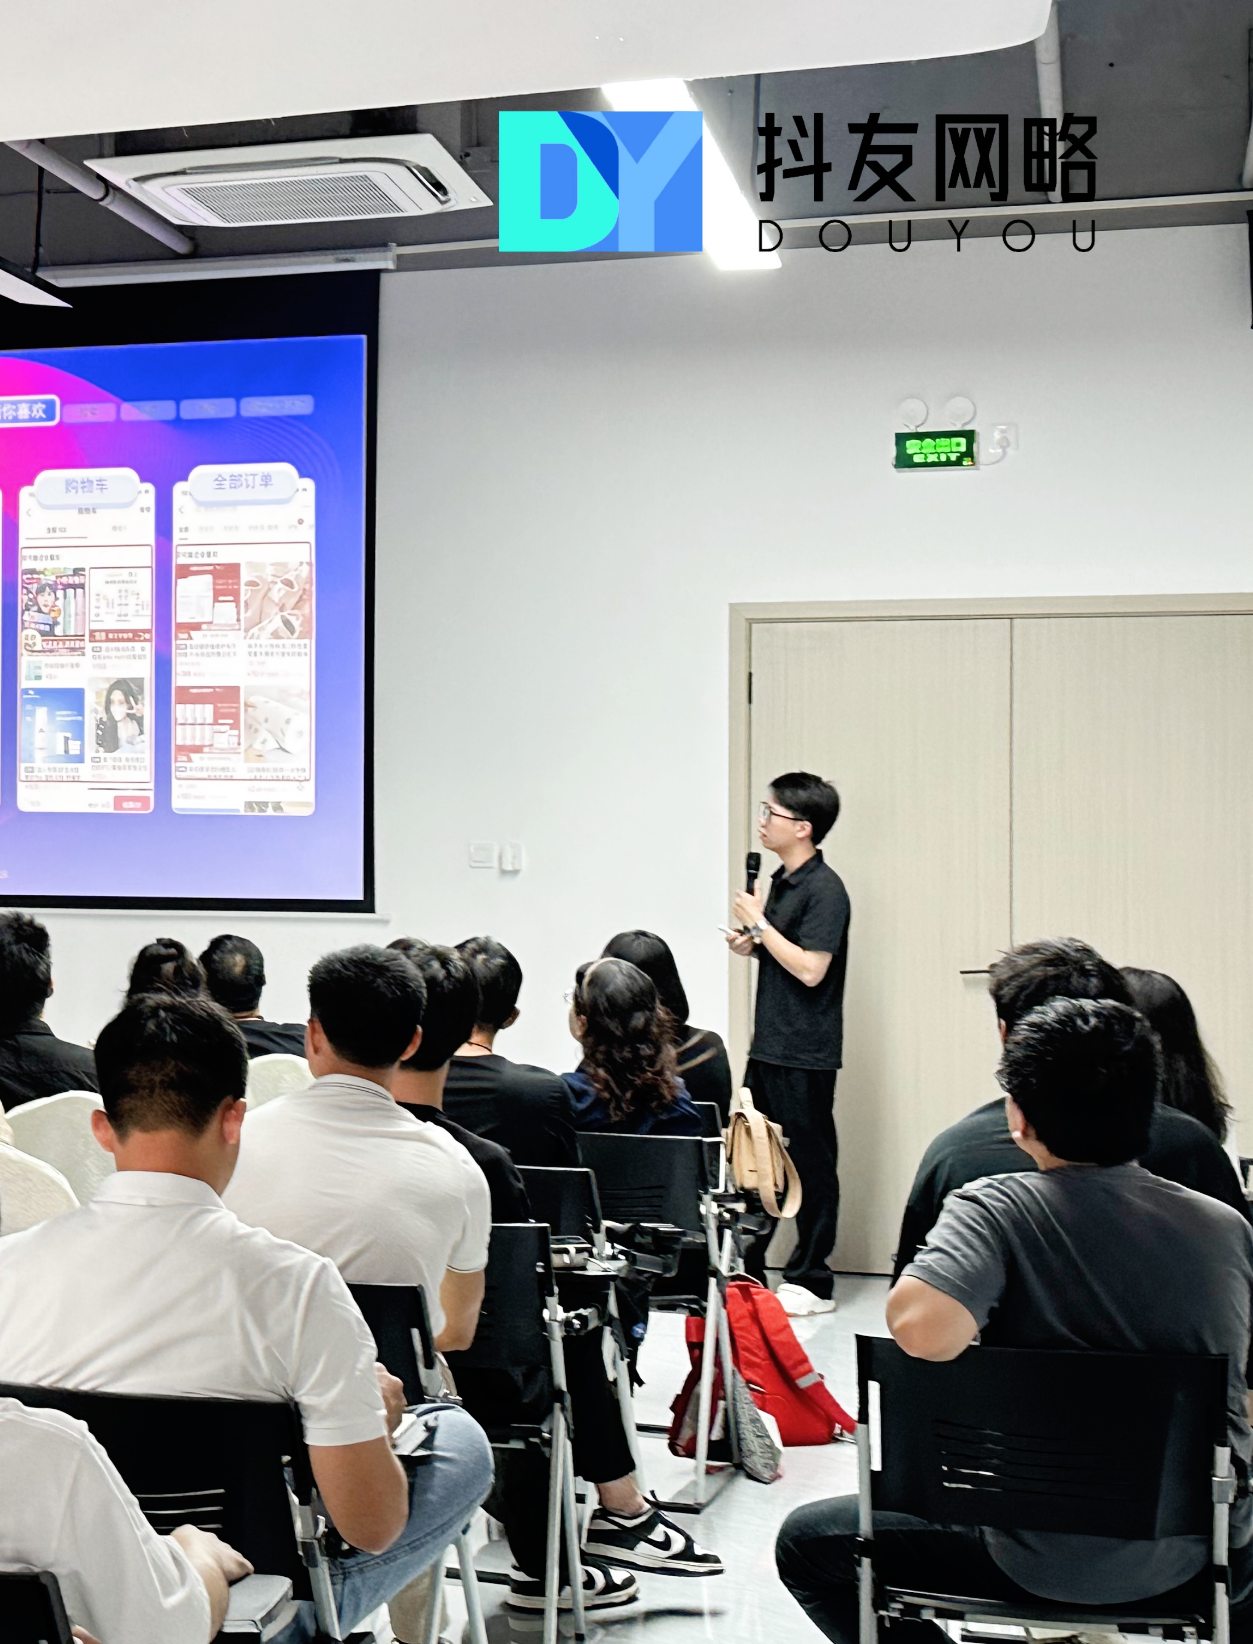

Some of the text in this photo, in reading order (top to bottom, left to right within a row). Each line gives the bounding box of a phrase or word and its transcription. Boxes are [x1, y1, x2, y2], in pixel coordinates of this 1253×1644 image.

[64, 477, 109, 494] 购物车
[212, 472, 274, 490] 全部订单
